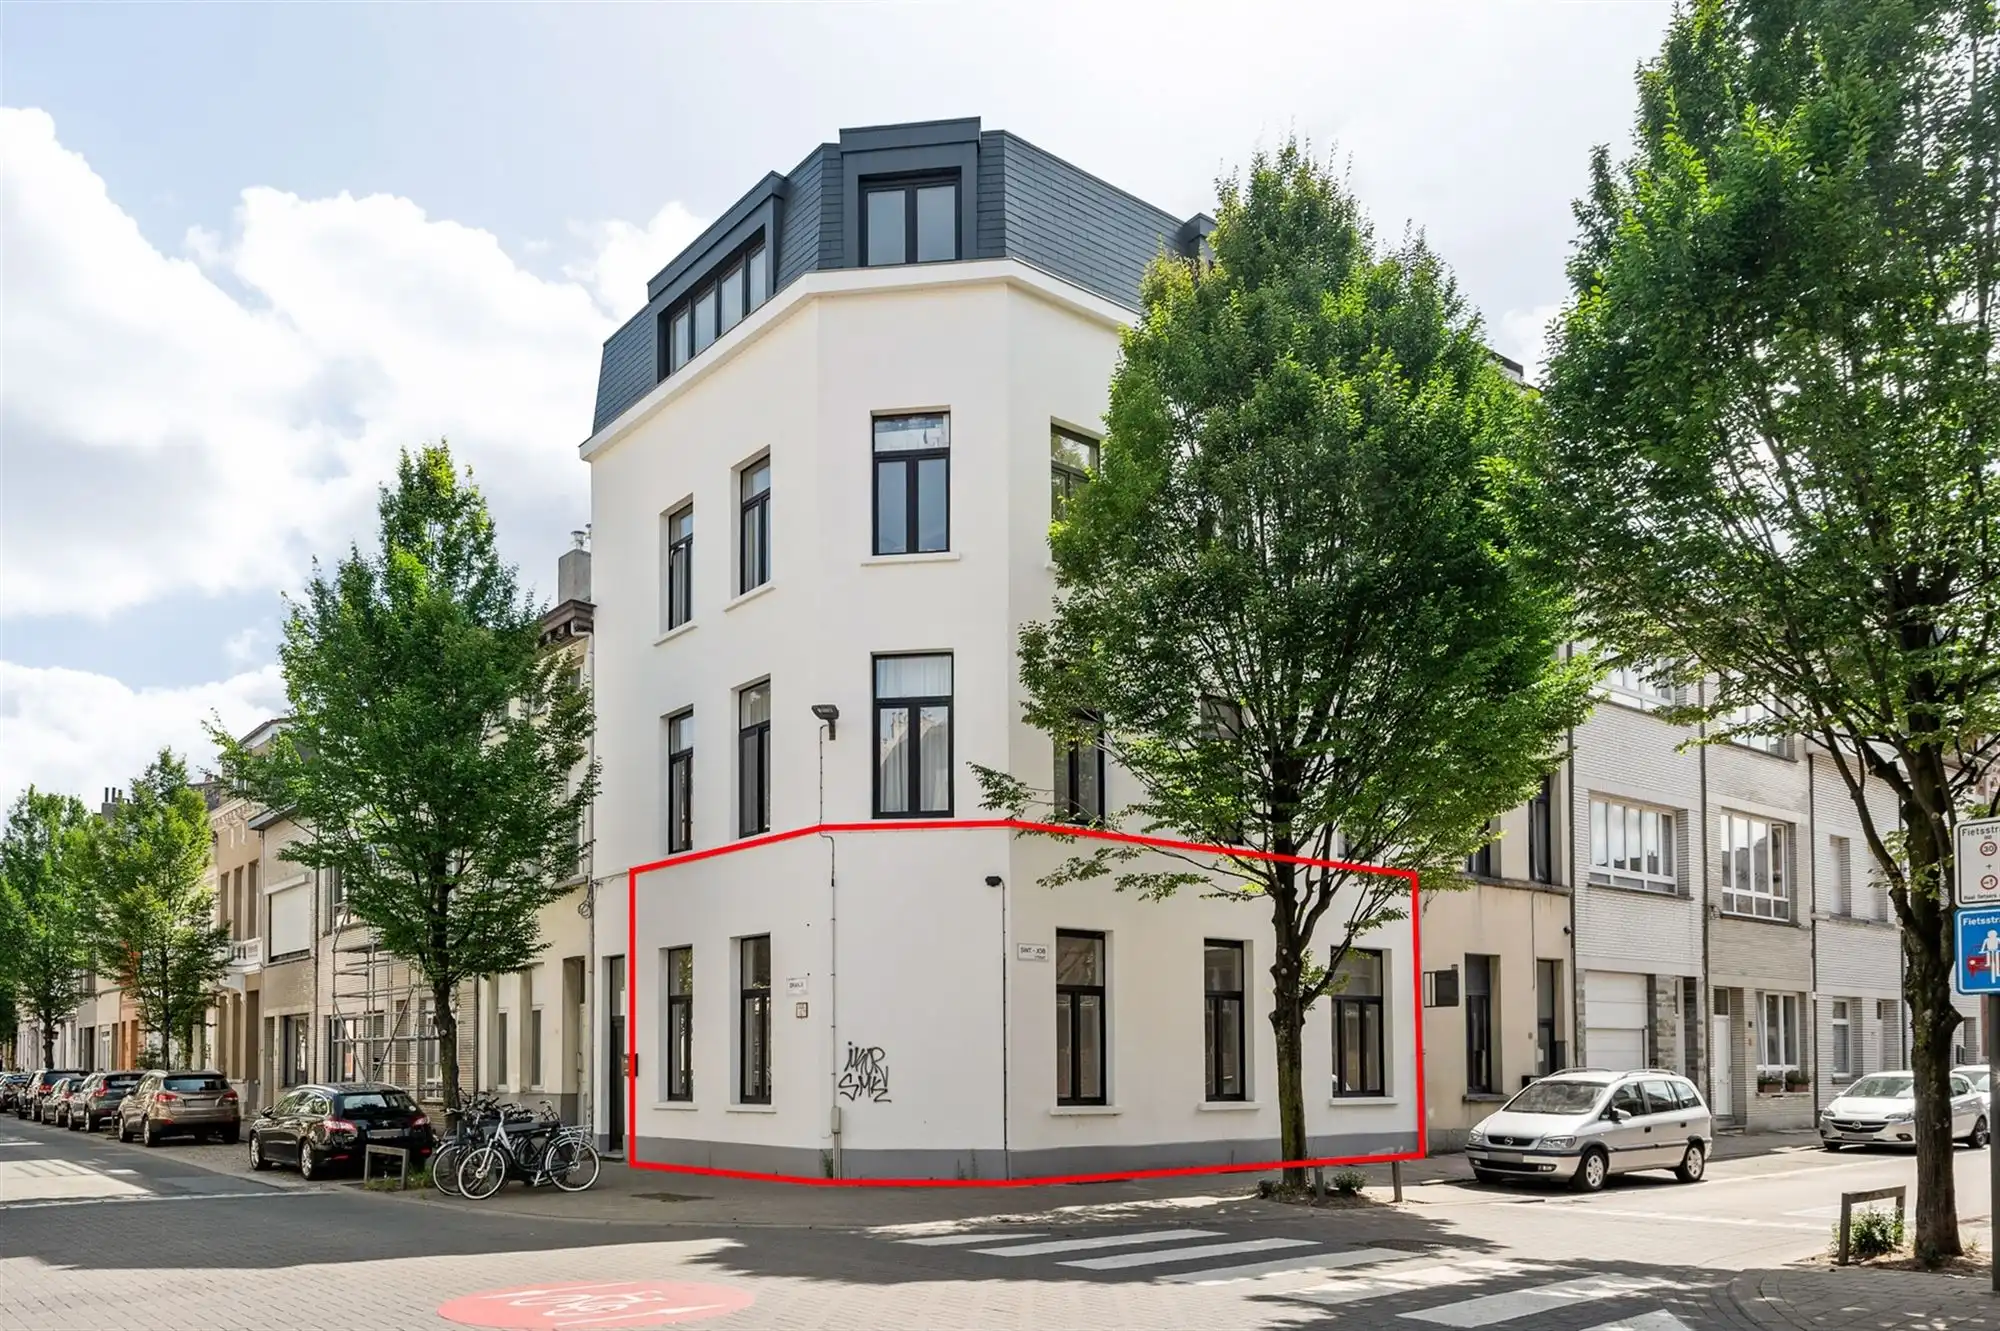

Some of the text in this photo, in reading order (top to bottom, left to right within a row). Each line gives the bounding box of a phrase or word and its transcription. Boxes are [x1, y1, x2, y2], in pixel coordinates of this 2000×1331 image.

[1962, 826, 2000, 836] Fietsstr
[1983, 845, 1994, 853] 30
[1963, 916, 2000, 926] Fietsstr
